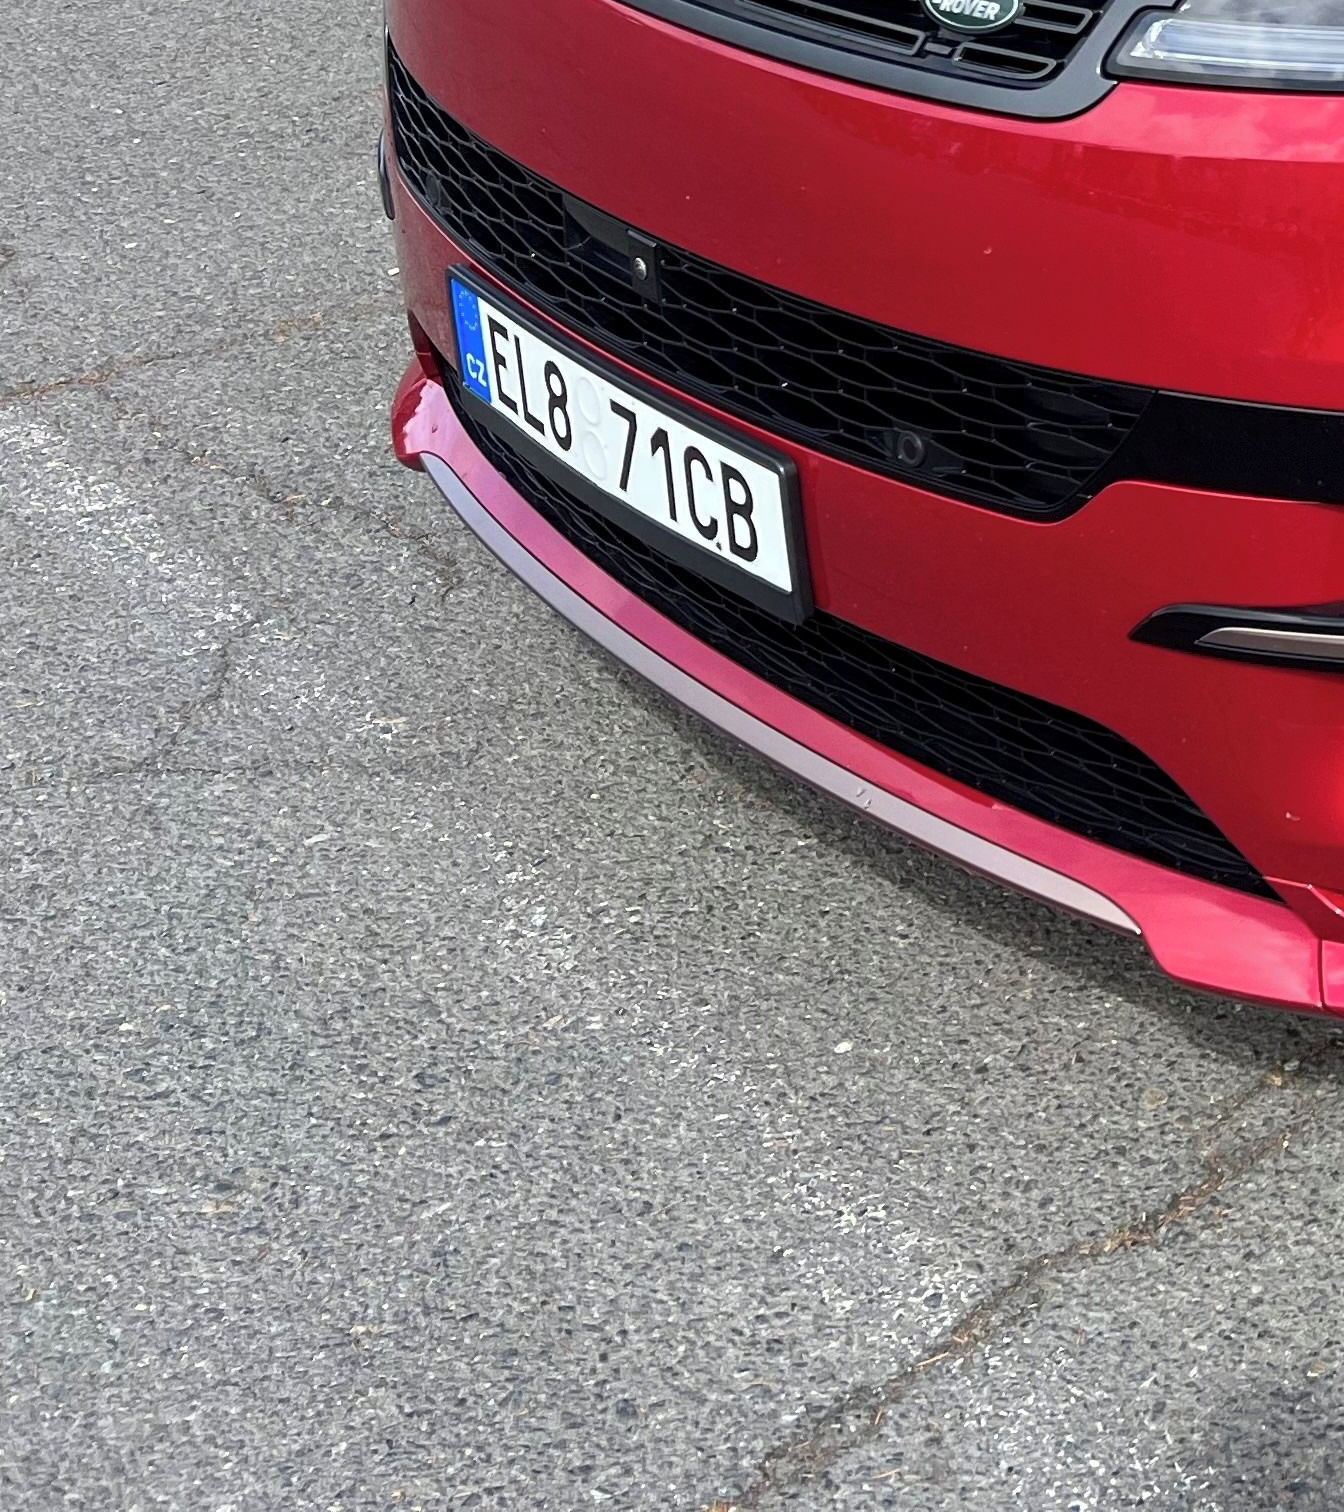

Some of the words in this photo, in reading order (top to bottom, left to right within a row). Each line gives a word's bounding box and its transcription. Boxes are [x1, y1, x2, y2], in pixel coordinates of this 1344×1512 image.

[466, 352, 488, 387] CZ
[487, 314, 573, 451] EL8
[609, 398, 759, 563] 71CB
